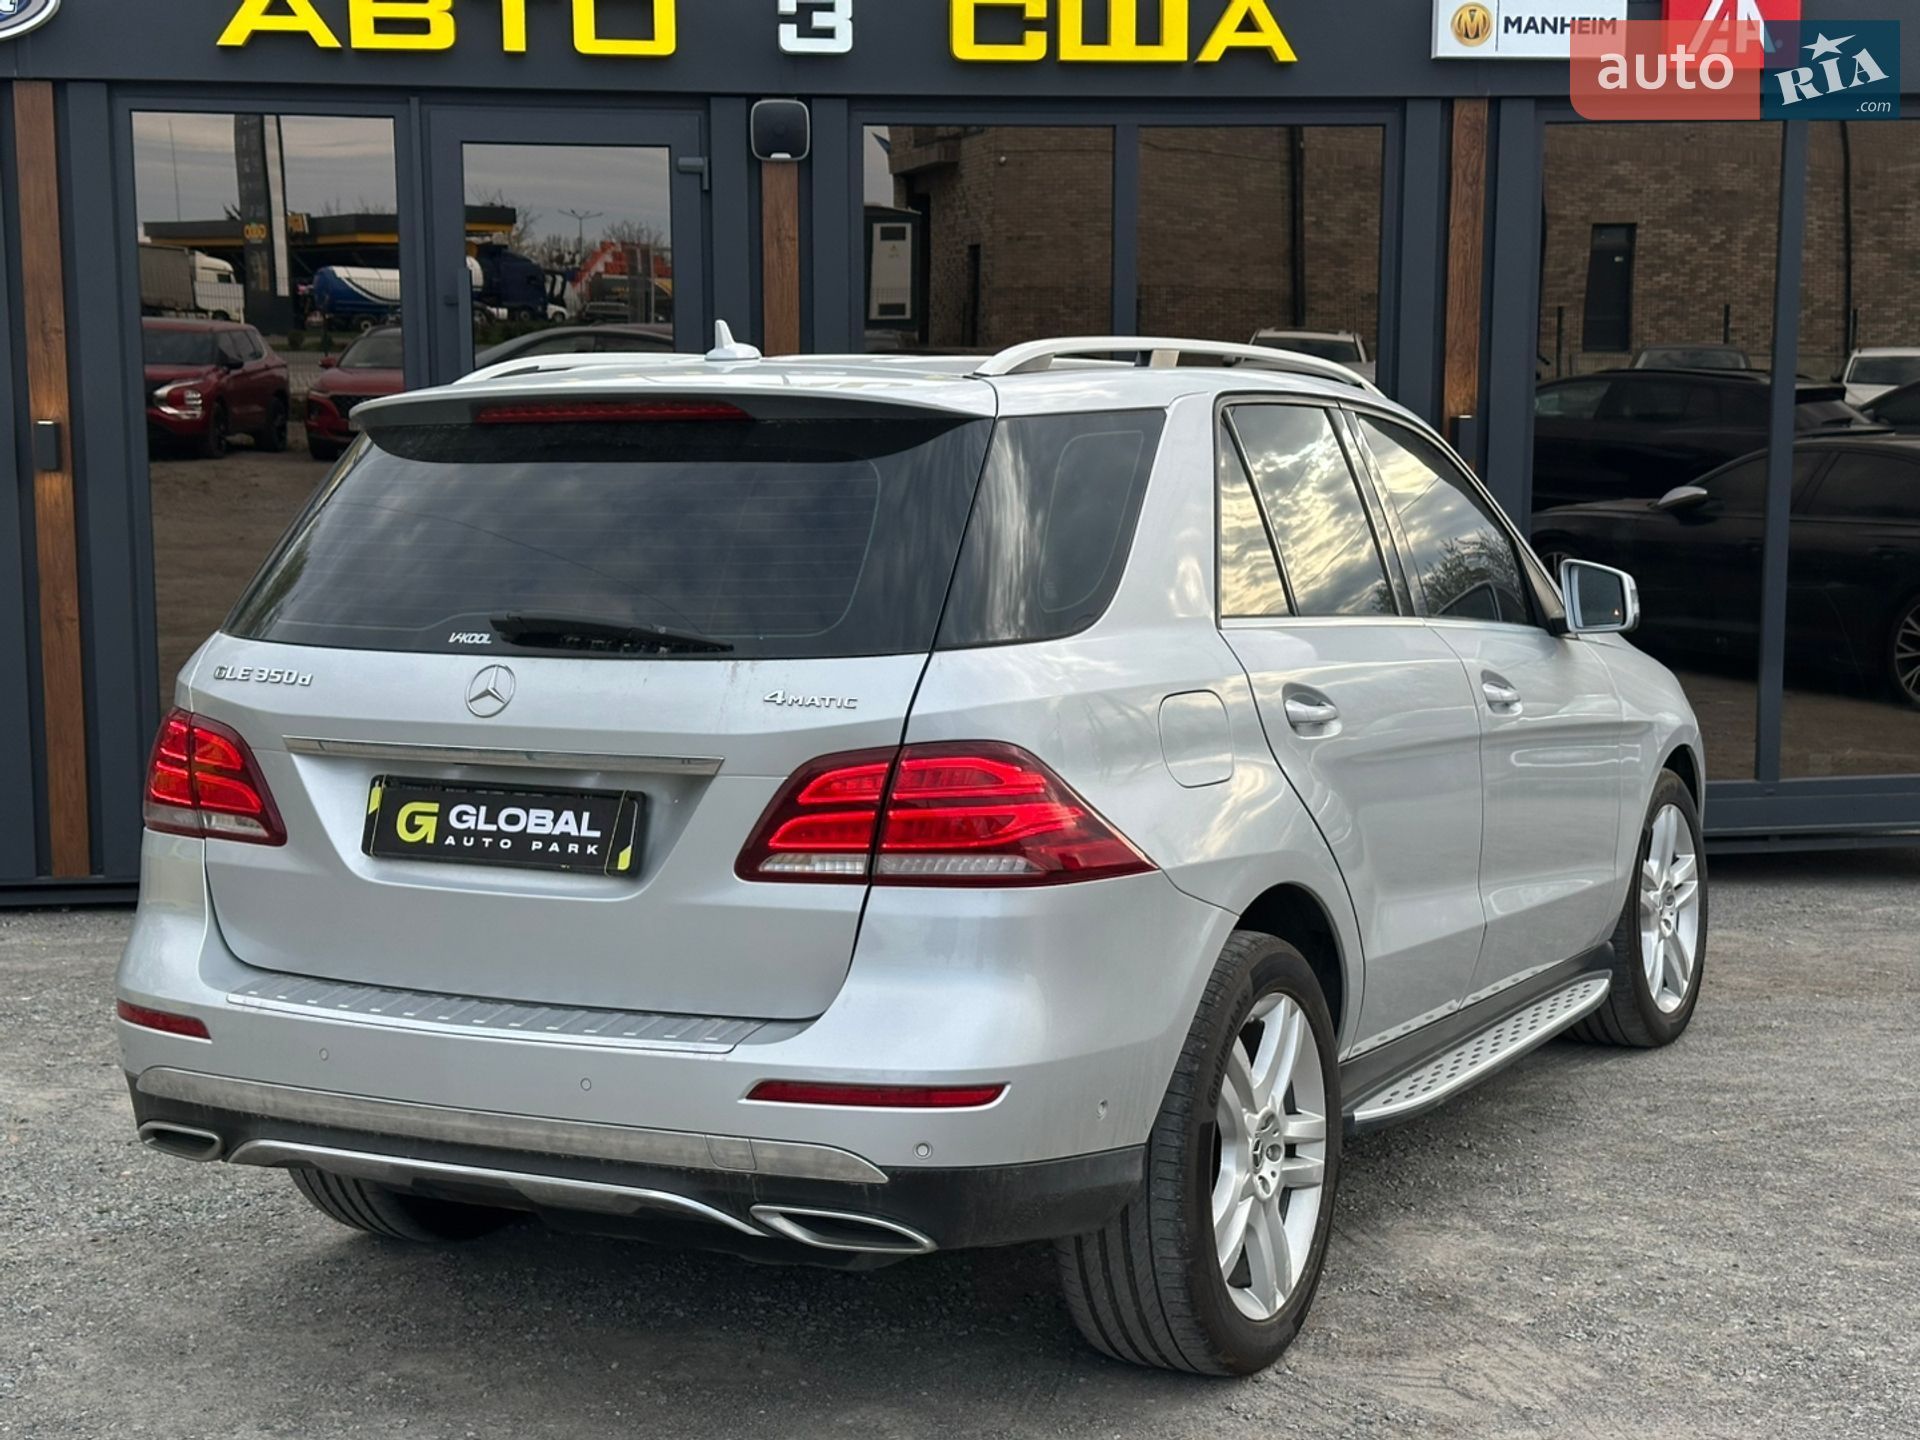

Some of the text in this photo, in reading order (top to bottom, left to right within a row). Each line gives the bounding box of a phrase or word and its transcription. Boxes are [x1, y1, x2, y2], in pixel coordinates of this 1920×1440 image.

[949, 0, 1298, 62] США
[1503, 16, 1617, 35] MANHEIM
[448, 632, 492, 644] V-KOOL
[214, 664, 254, 682] GLE
[764, 689, 858, 709] 4MATIC
[448, 804, 601, 838] GLOBAL
[444, 836, 599, 855] AUTO PARK
